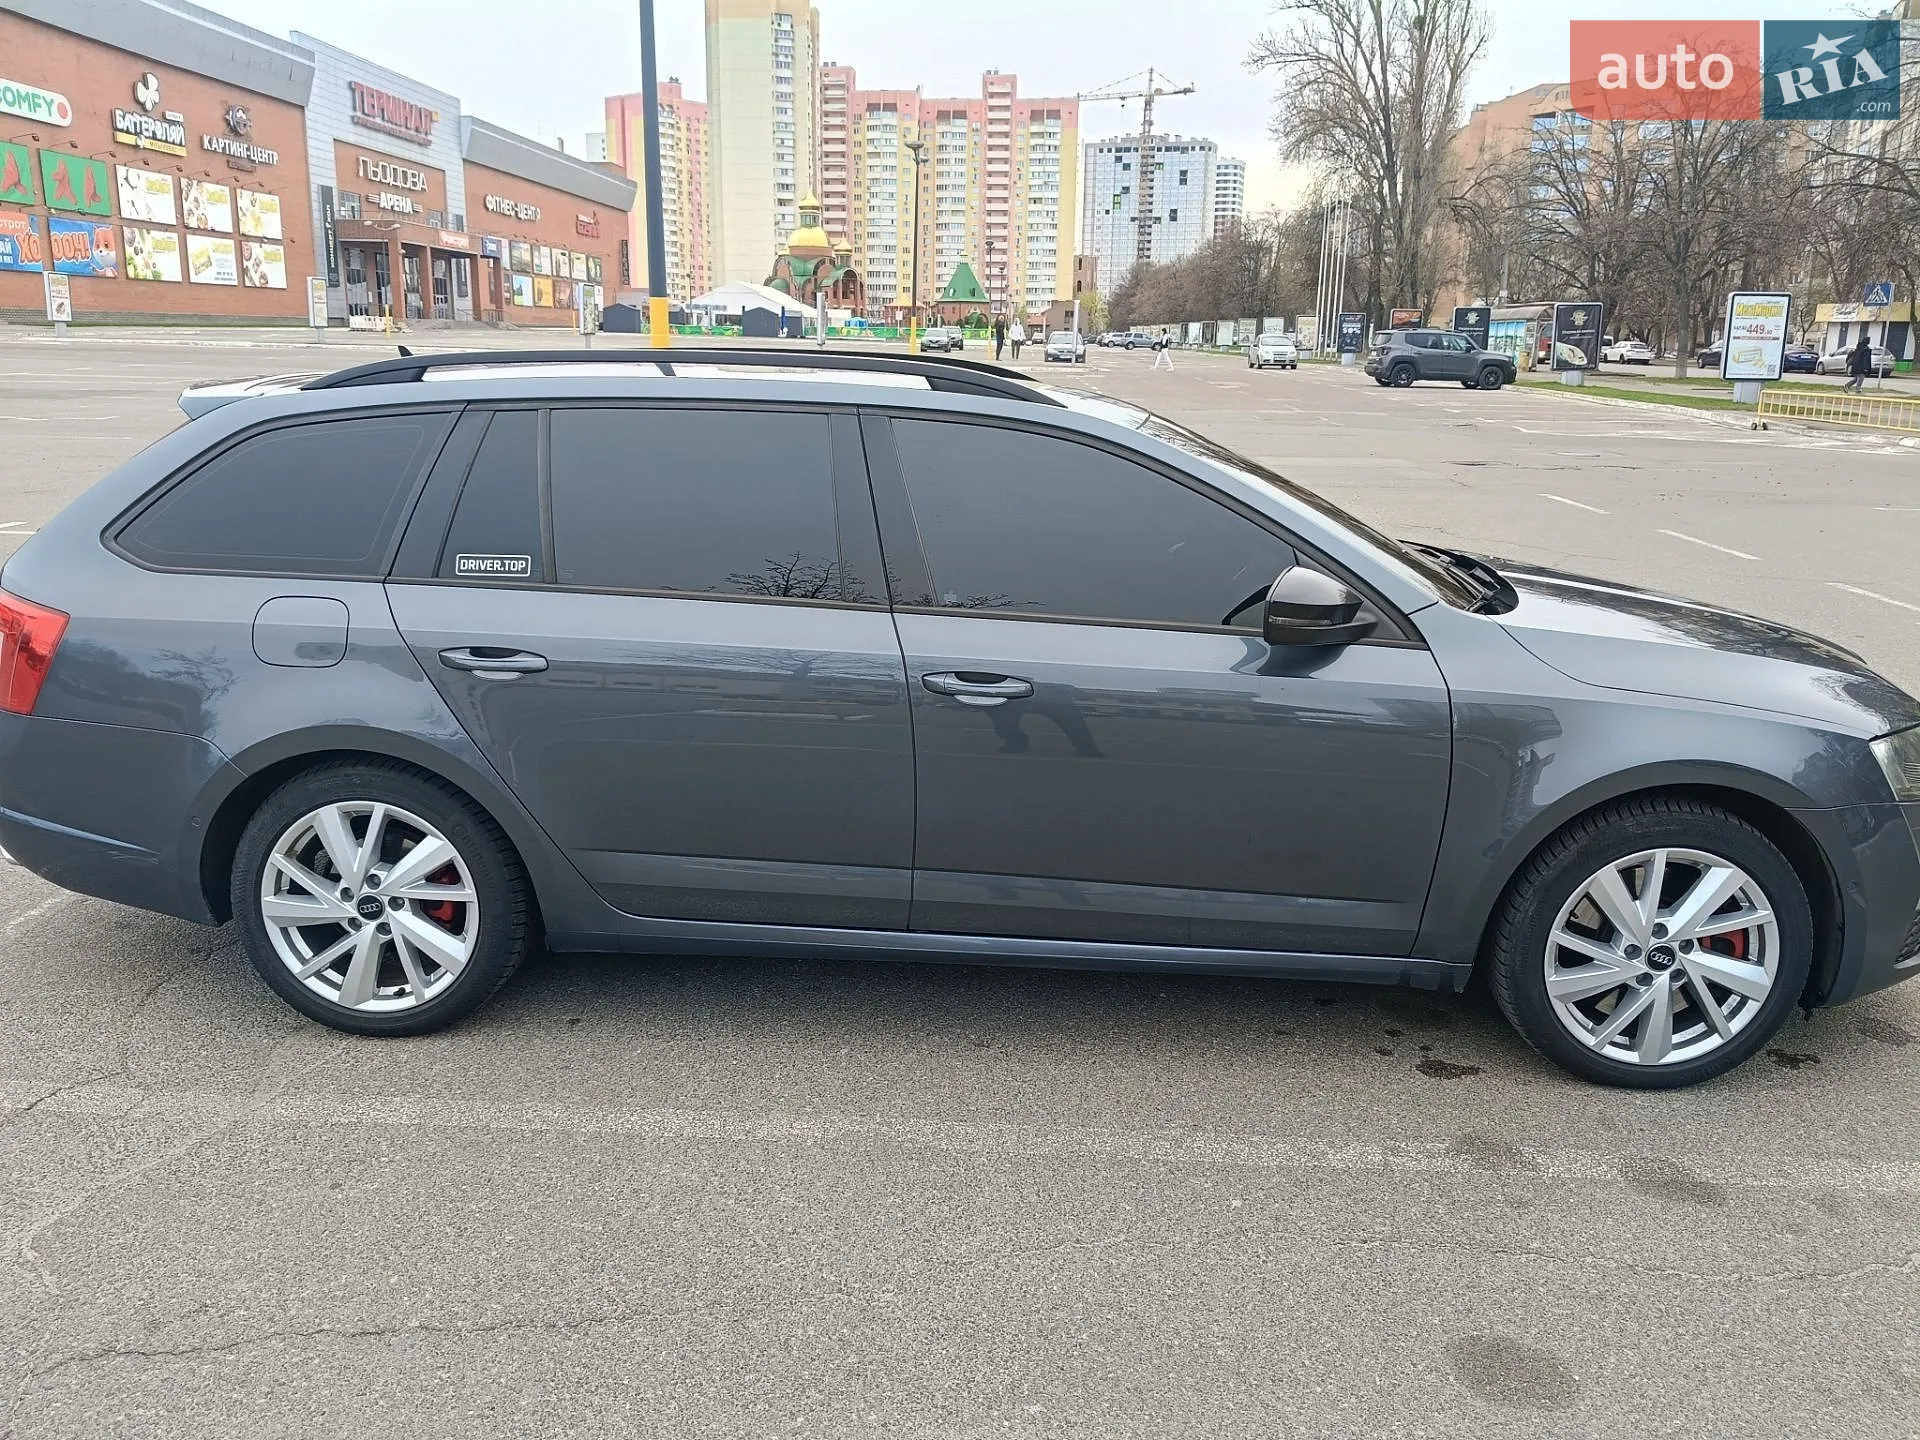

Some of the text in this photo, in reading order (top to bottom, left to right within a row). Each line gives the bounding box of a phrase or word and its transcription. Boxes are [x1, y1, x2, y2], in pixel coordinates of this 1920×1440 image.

[0, 86, 54, 117] OMFY
[114, 108, 186, 146] БАТТЕРФЛЯЙ
[202, 134, 279, 165] КАРТИНГ-ЦЕНТР
[359, 156, 429, 192] ЛЬОДОВА
[379, 191, 414, 214] АРЕНА
[460, 559, 526, 571] DRIVER.TOP
